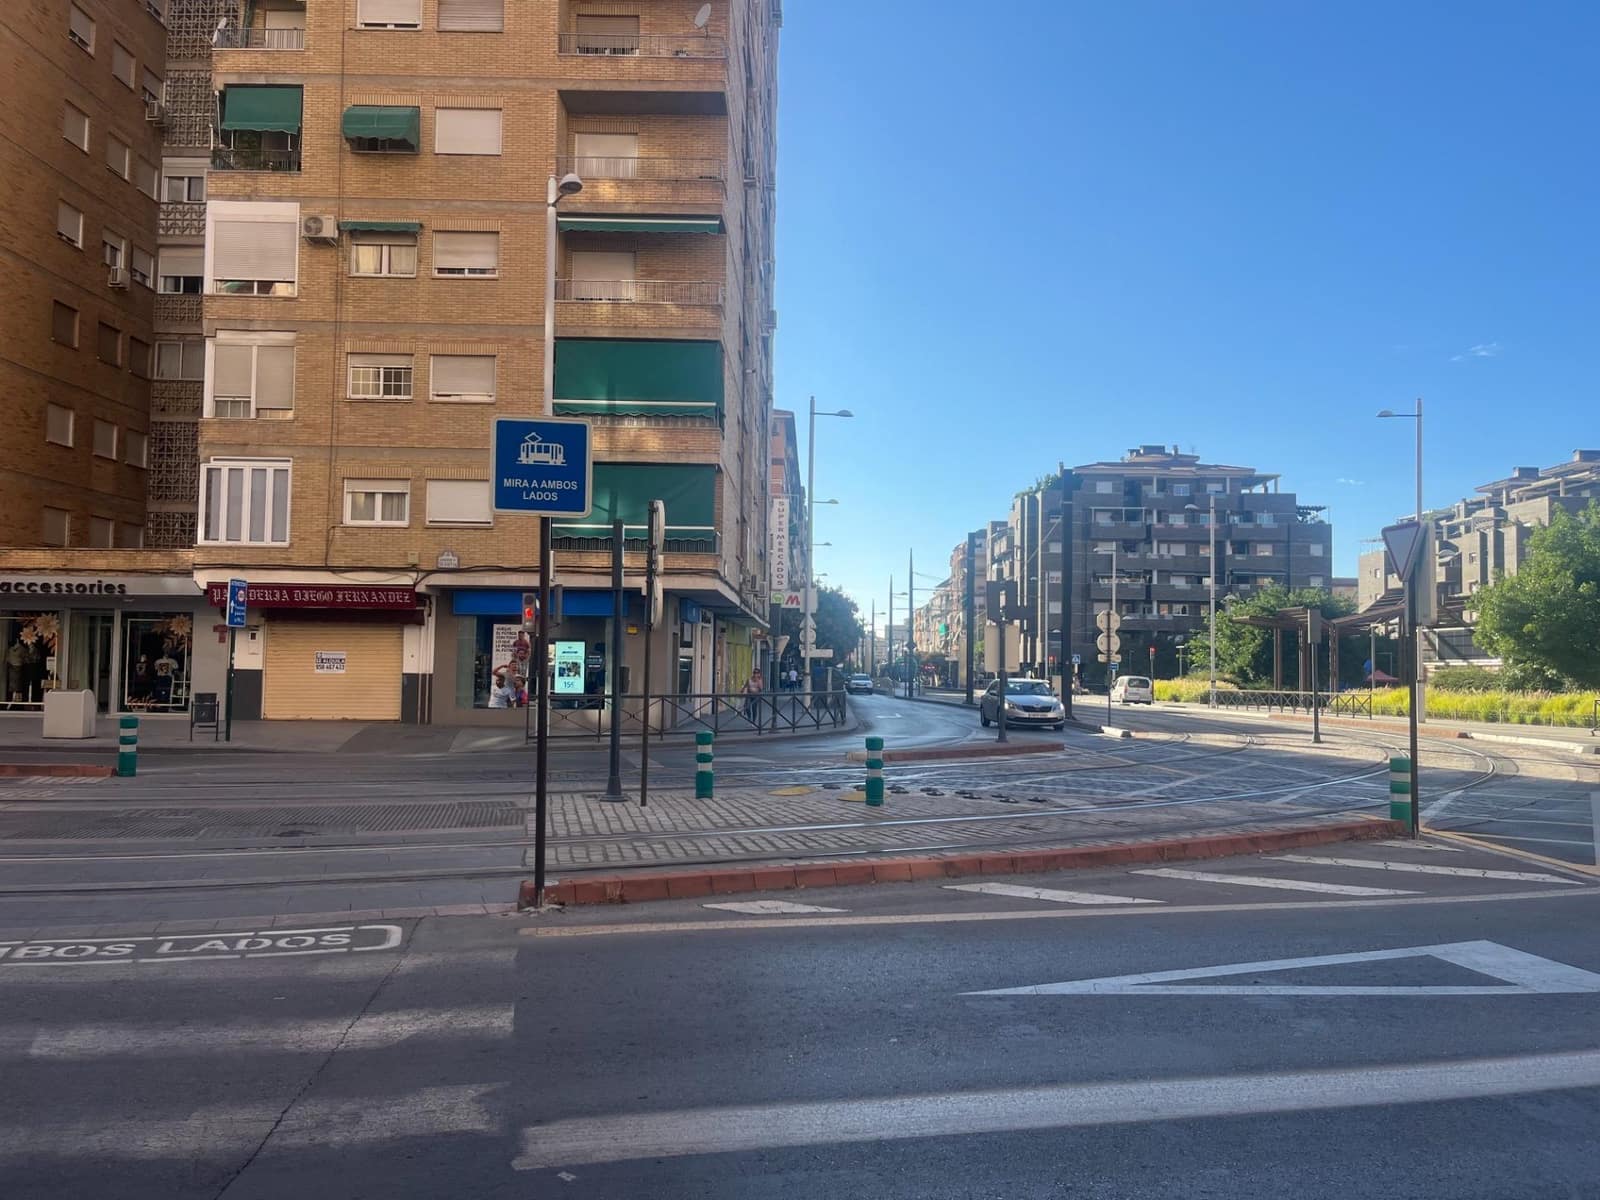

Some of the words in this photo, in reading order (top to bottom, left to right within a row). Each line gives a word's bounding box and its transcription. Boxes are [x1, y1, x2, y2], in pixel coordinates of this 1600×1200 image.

[503, 478, 529, 488] MIRA
[531, 479, 539, 489] A
[540, 480, 578, 490] AMBOS
[523, 491, 558, 501] LADOS
[775, 501, 786, 586] SUPERMERCADOS
[0, 580, 126, 594] accessories
[212, 588, 290, 603] PADERIA
[293, 589, 334, 602] DIEGO
[336, 591, 411, 603] FERNANDEZ
[156, 933, 352, 954] LADOS
